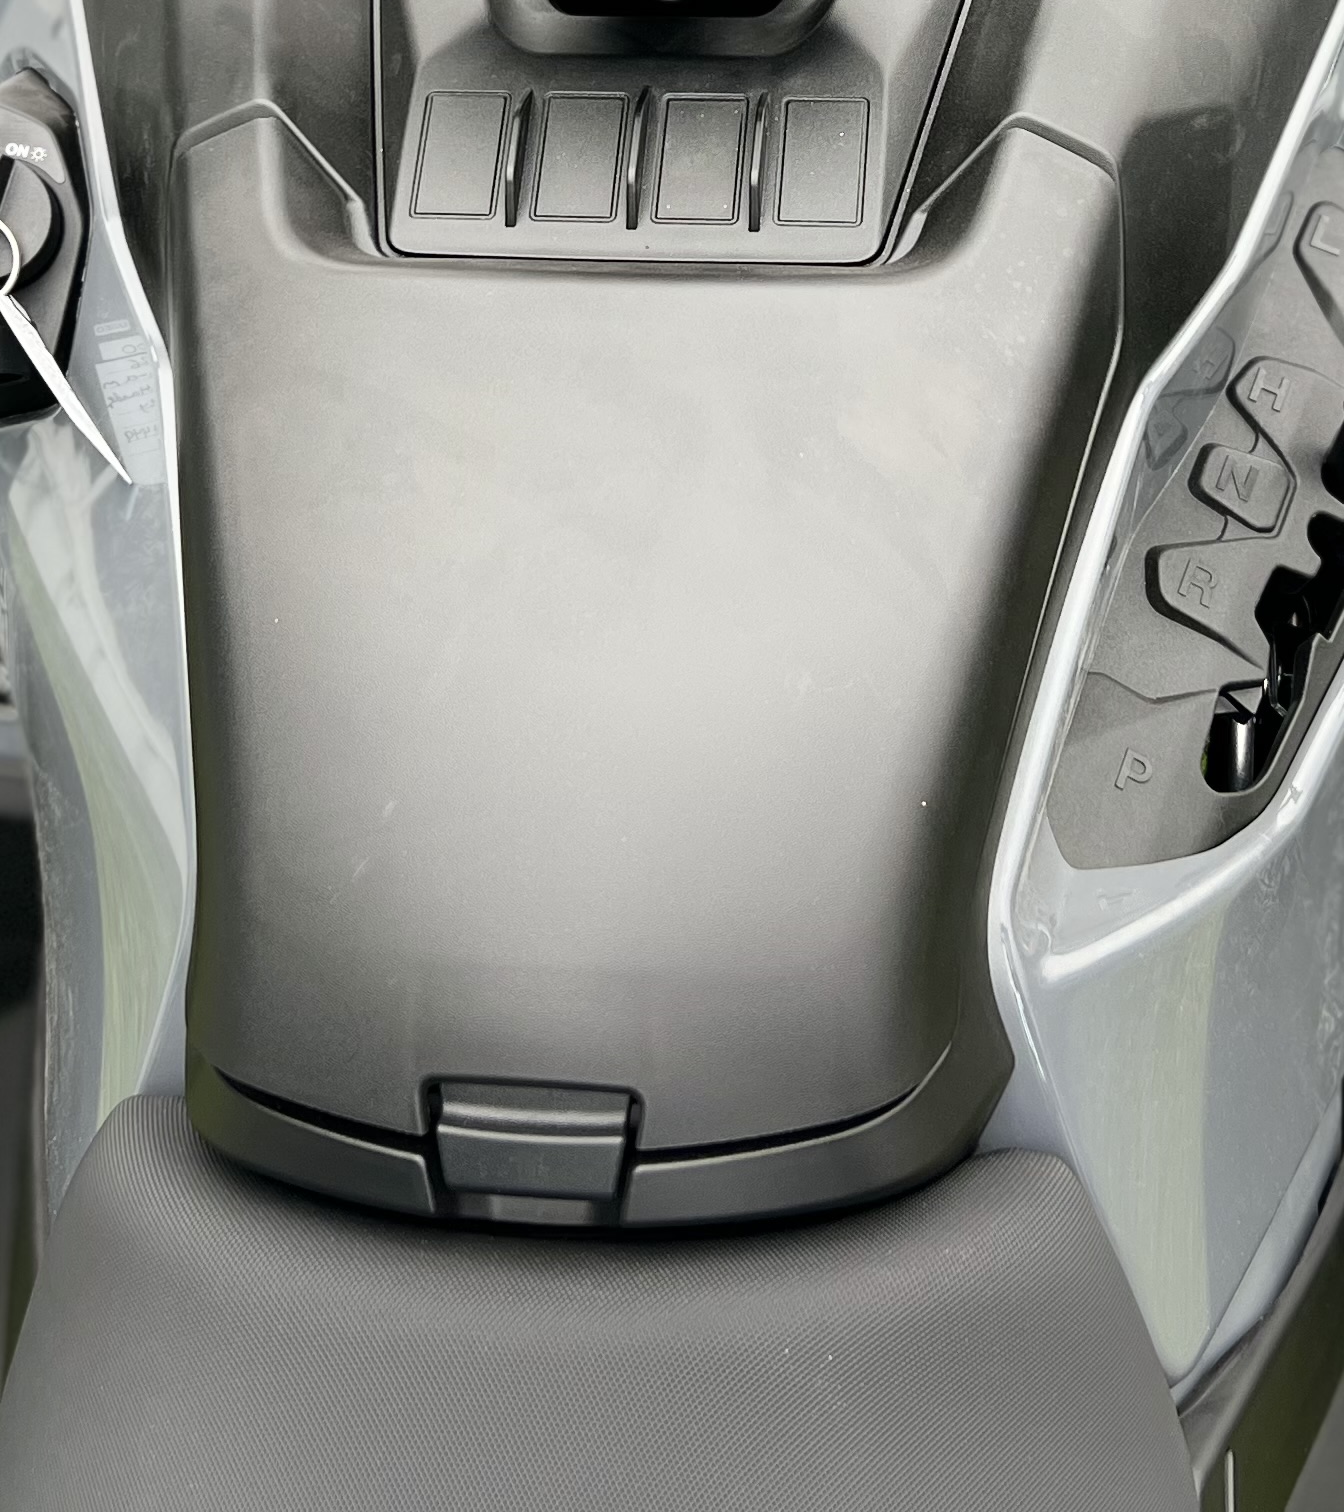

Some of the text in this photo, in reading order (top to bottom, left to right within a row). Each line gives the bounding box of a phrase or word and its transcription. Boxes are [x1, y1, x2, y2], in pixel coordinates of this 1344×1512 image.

[6, 142, 30, 157] ON
[1310, 214, 1341, 256] L
[1248, 367, 1290, 412] H
[1215, 455, 1260, 502] N
[1178, 558, 1217, 609] R
[1115, 747, 1153, 790] P
